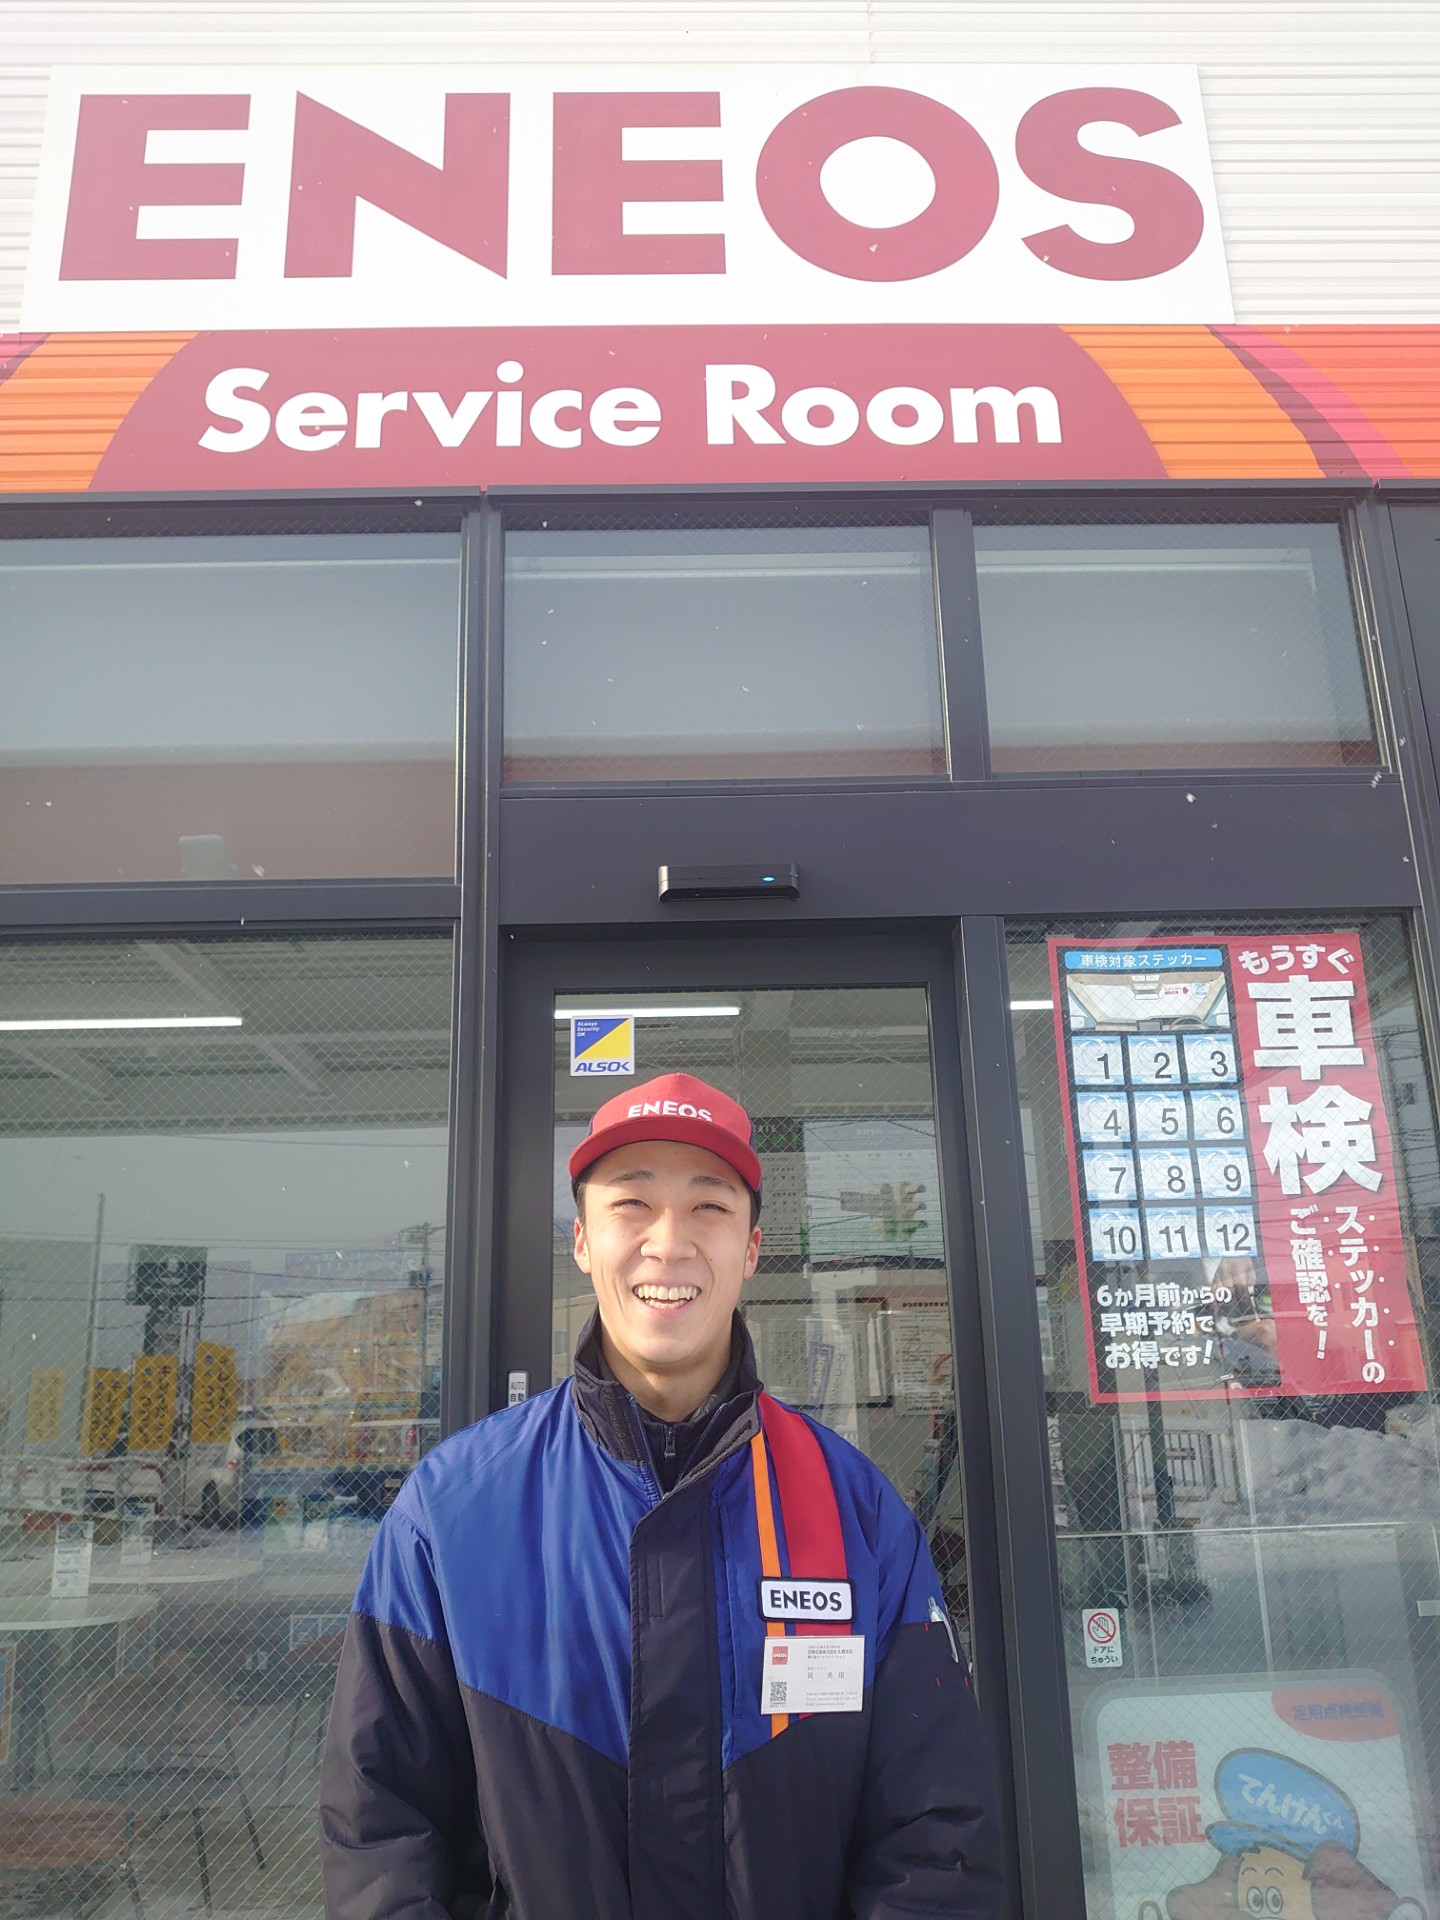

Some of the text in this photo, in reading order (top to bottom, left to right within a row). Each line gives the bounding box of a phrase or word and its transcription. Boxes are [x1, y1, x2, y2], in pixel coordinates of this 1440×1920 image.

[58, 85, 1205, 283] ENEOS
[198, 360, 1064, 453] Service Room
[1081, 952, 1207, 968] 車検対象ステッカー
[1238, 944, 1355, 975] もうすぐ
[575, 1061, 631, 1073] ALSOK
[1097, 1053, 1111, 1080] 1
[1153, 1052, 1172, 1079] 2
[1210, 1050, 1228, 1077] 3
[1247, 975, 1383, 1195] 車検
[627, 1100, 713, 1122] ENEOS
[1103, 1109, 1122, 1136] 4
[1161, 1108, 1179, 1135] 5
[1216, 1106, 1235, 1134] 6
[1109, 1166, 1127, 1194] 7
[1167, 1165, 1186, 1193] 8
[1223, 1164, 1242, 1192] 9
[1103, 1225, 1136, 1255] 10
[1158, 1225, 1189, 1253] 11
[1216, 1223, 1252, 1252] 12
[1096, 1282, 1233, 1308] 6か月前からの
[1289, 1204, 1332, 1360] ご確認を!
[1335, 1206, 1386, 1385] ステッカーの
[1100, 1310, 1215, 1338] 早期予約で
[1104, 1339, 1214, 1370] お得です!
[770, 1589, 843, 1612] ENEOS
[1090, 1655, 1119, 1664] ちゅうい
[1093, 1645, 1116, 1654] ドアに
[1106, 1740, 1198, 1791] 整備
[1113, 1796, 1206, 1848] 保証
